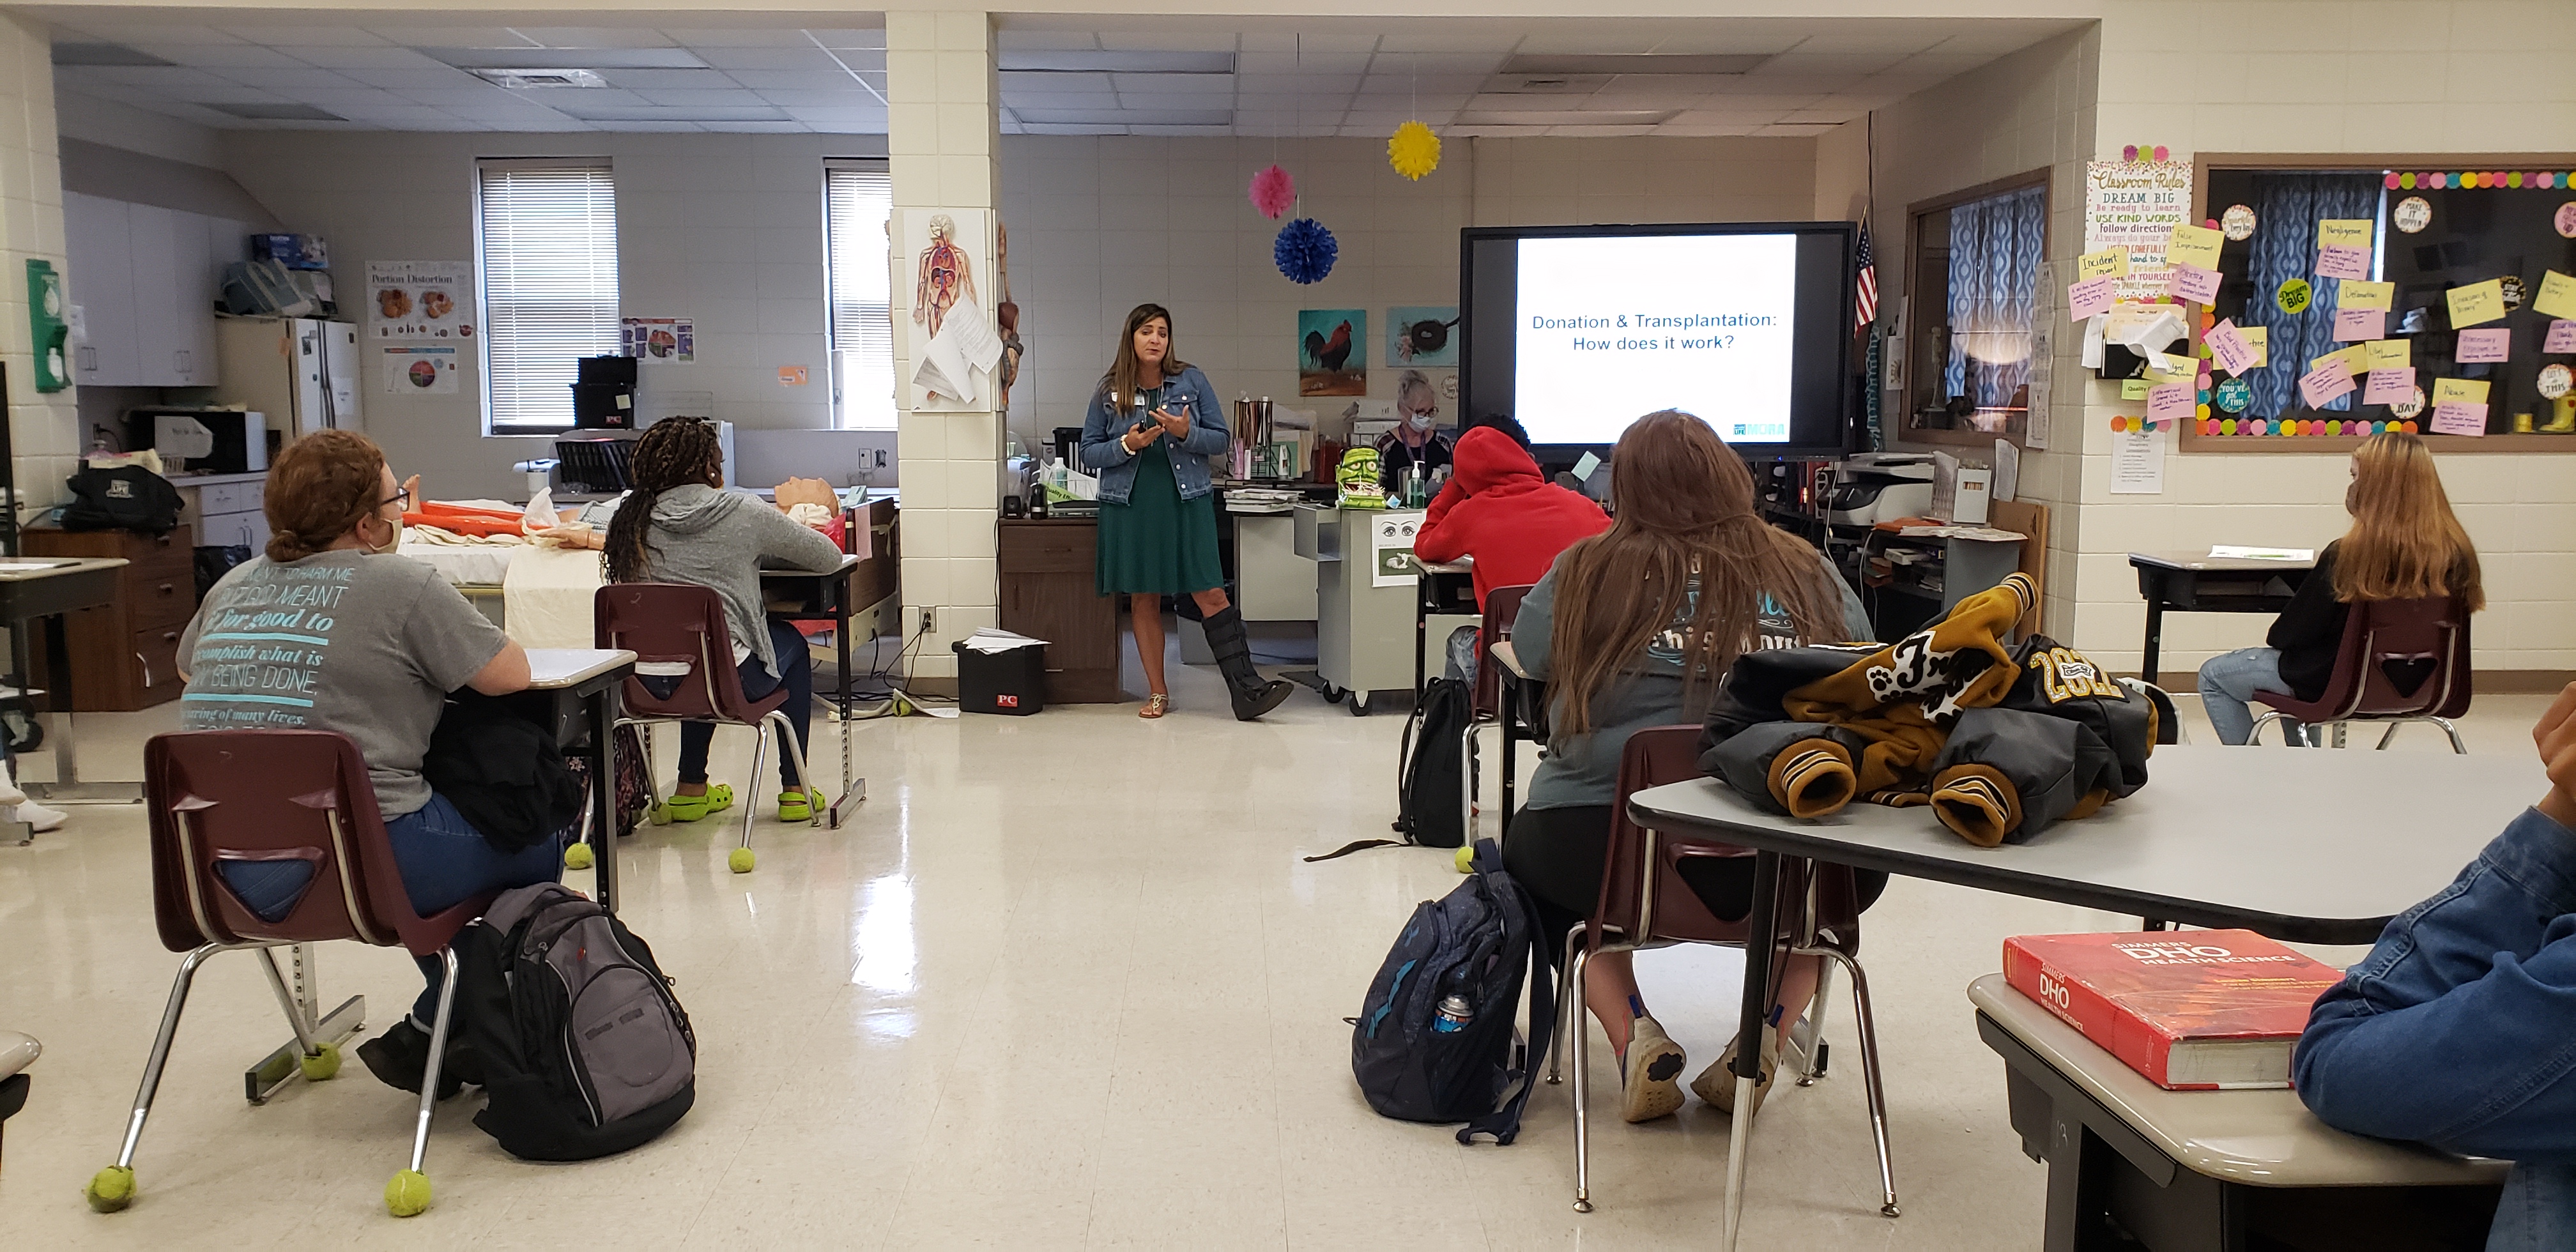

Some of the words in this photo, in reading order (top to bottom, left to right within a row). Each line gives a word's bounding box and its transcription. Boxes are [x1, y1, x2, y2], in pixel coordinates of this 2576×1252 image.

[2093, 171, 2152, 190] Classroom
[2156, 168, 2186, 191] Rules
[2103, 193, 2147, 203] DREAM
[2154, 193, 2174, 203] BIG
[2111, 204, 2136, 215] ready
[2100, 223, 2128, 233] Follow
[2094, 234, 2126, 243] Always
[2140, 235, 2161, 243] your
[2131, 244, 2166, 253] CAREFULLY
[2083, 253, 2119, 270] Incident
[2130, 254, 2147, 263] hand
[372, 274, 404, 283] Portion
[408, 274, 452, 283] Distortion
[2287, 293, 2304, 308] BIG
[1533, 315, 1610, 329] Donation
[1616, 315, 1629, 328] &
[1634, 313, 1777, 331] Transplantation:
[1574, 337, 1611, 351] How
[1617, 337, 1658, 351] does
[1665, 335, 1675, 350] it
[1681, 335, 1735, 350] work?
[2545, 385, 2566, 393] THIS
[2398, 403, 2416, 413] DAY
[332, 568, 356, 581] ME
[275, 585, 349, 609] MEANT
[243, 609, 307, 631] good
[305, 613, 335, 632] to
[258, 646, 303, 664] what
[306, 650, 324, 666] is
[211, 664, 258, 687] BEING
[261, 665, 318, 696] DONE,
[998, 694, 1017, 705] PC
[232, 711, 265, 723] many
[267, 709, 307, 726] lives.
[2120, 946, 2232, 959] DHO
[2216, 955, 2296, 963] SCIENCE
[2041, 963, 2066, 984] SIMMERS
[2039, 973, 2070, 1009] DHO
